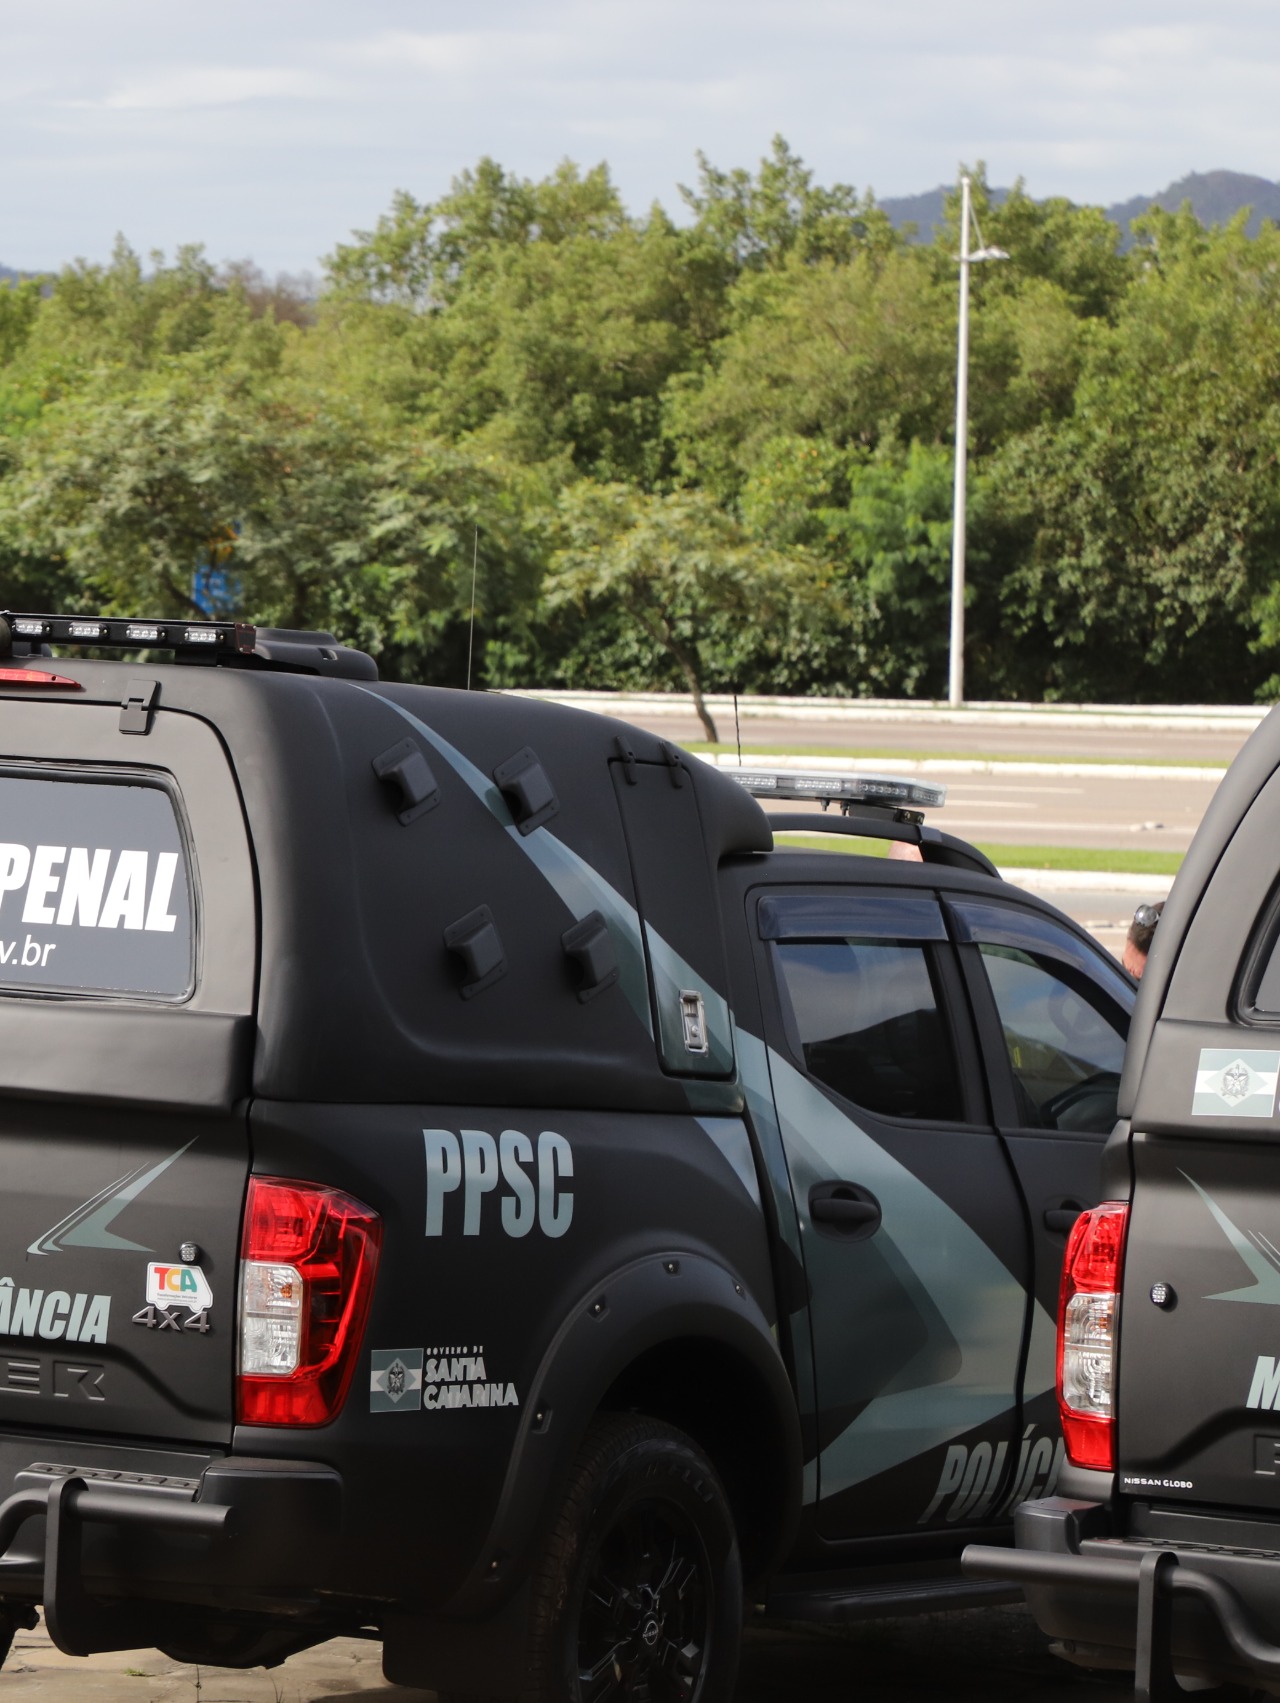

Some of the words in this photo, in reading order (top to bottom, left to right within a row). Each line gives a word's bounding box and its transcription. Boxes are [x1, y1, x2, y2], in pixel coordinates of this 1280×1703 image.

[422, 1129, 574, 1238] PPSC
[154, 1267, 197, 1292] TCA
[425, 1356, 487, 1383] SANTA
[423, 1382, 519, 1410] CATARINA
[1124, 1477, 1161, 1486] NISSAN
[1163, 1479, 1193, 1489] GLOBO
